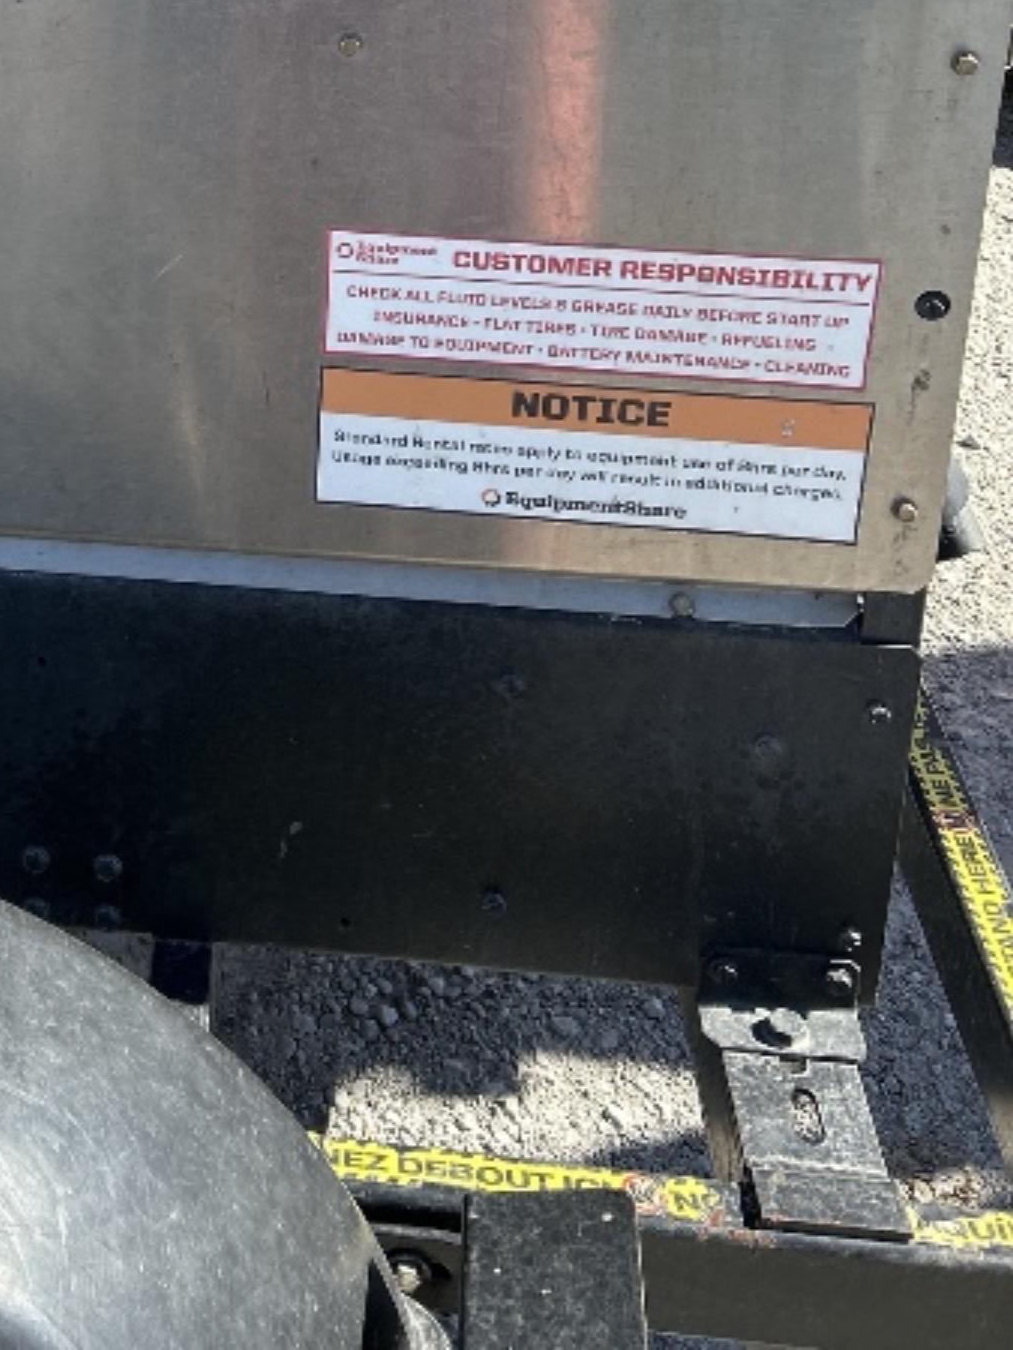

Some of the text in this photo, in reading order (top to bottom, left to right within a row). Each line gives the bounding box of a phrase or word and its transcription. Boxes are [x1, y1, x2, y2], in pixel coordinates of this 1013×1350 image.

[453, 250, 873, 292] CUSTOMER RESPONSIBILITY
[571, 299, 637, 317] GREASE
[696, 307, 763, 325] BEFORE
[766, 311, 823, 329] START
[546, 344, 621, 363] BATTERY
[511, 390, 673, 428] NOTICE
[504, 490, 688, 520] EquipmentShare
[397, 1155, 557, 1192] DEBOUT
